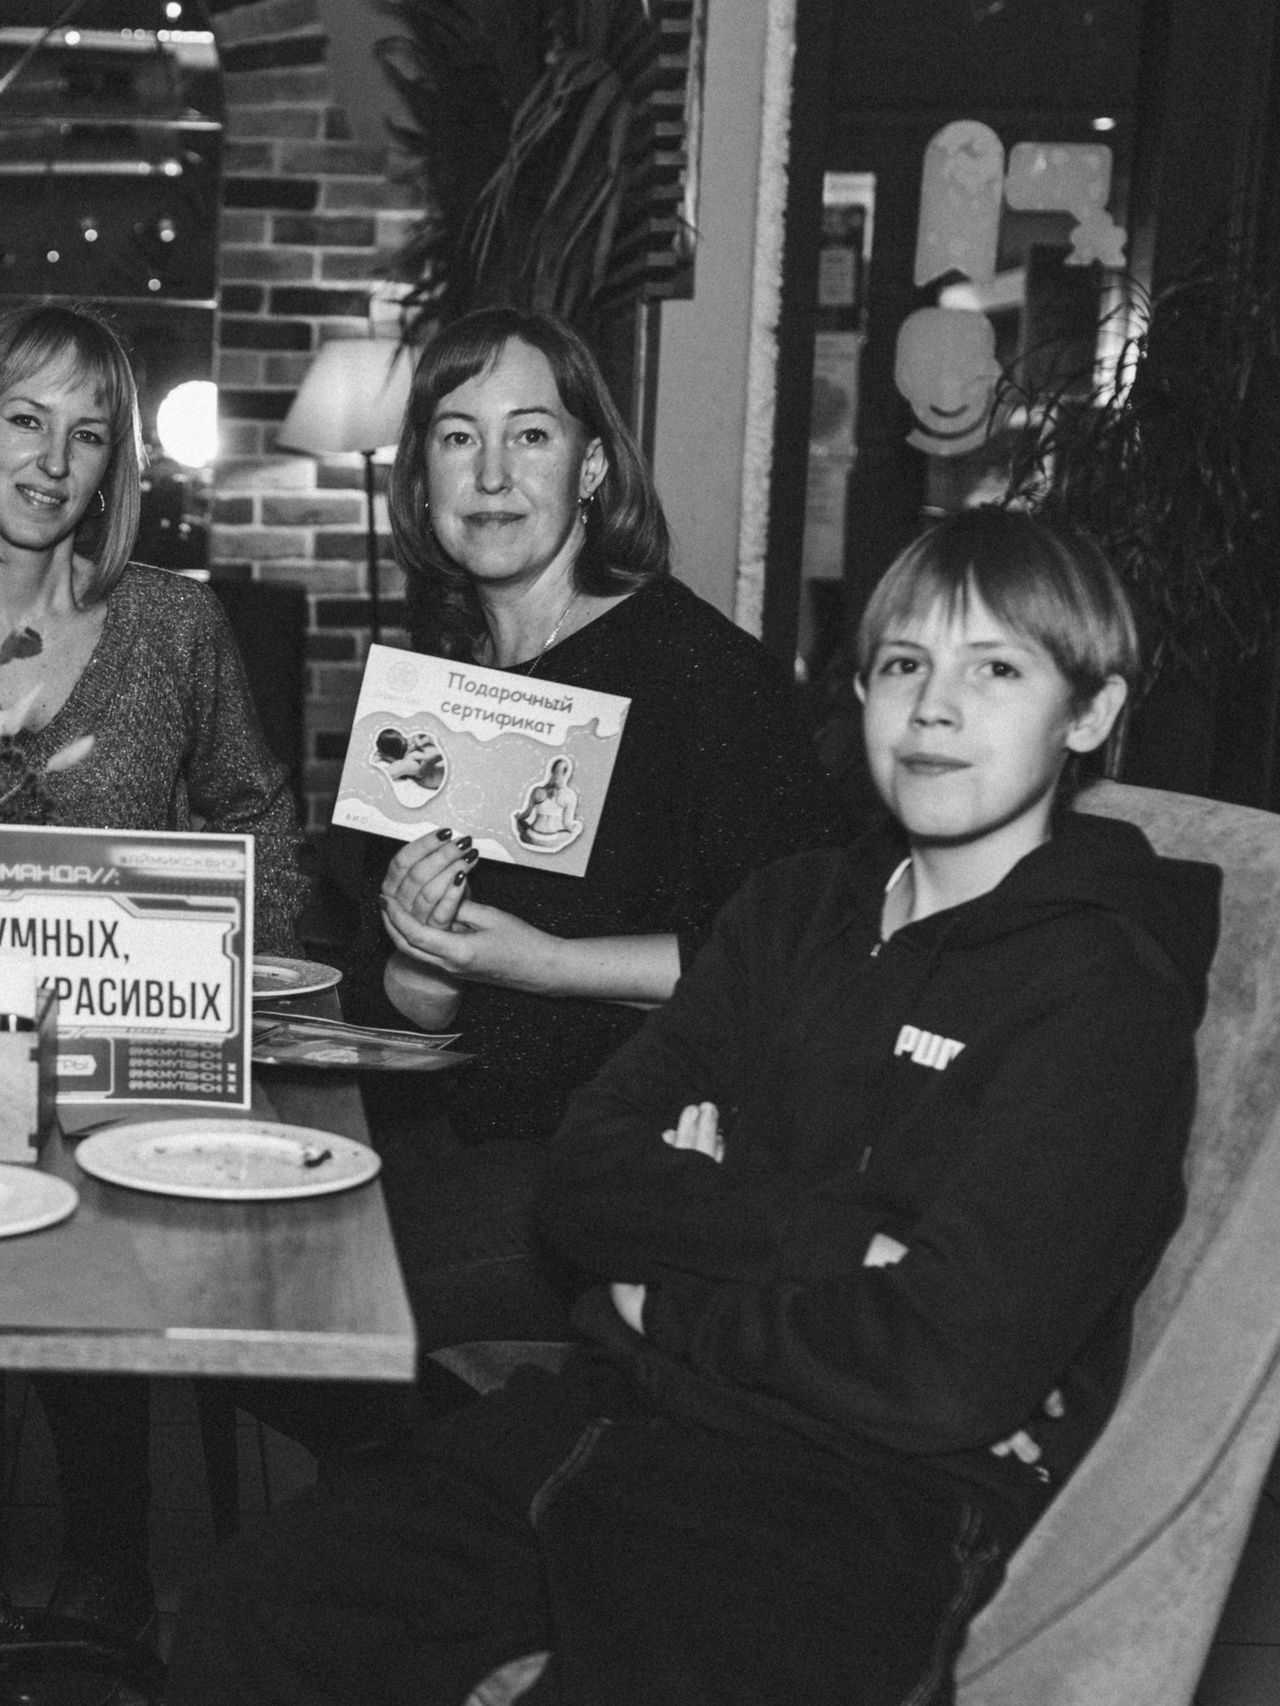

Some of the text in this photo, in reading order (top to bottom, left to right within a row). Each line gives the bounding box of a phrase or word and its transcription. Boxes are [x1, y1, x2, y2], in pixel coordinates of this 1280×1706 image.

[447, 671, 574, 714] Подарочный
[440, 698, 555, 736] сертификат
[38, 976, 222, 1021] РАСИВЫХ
